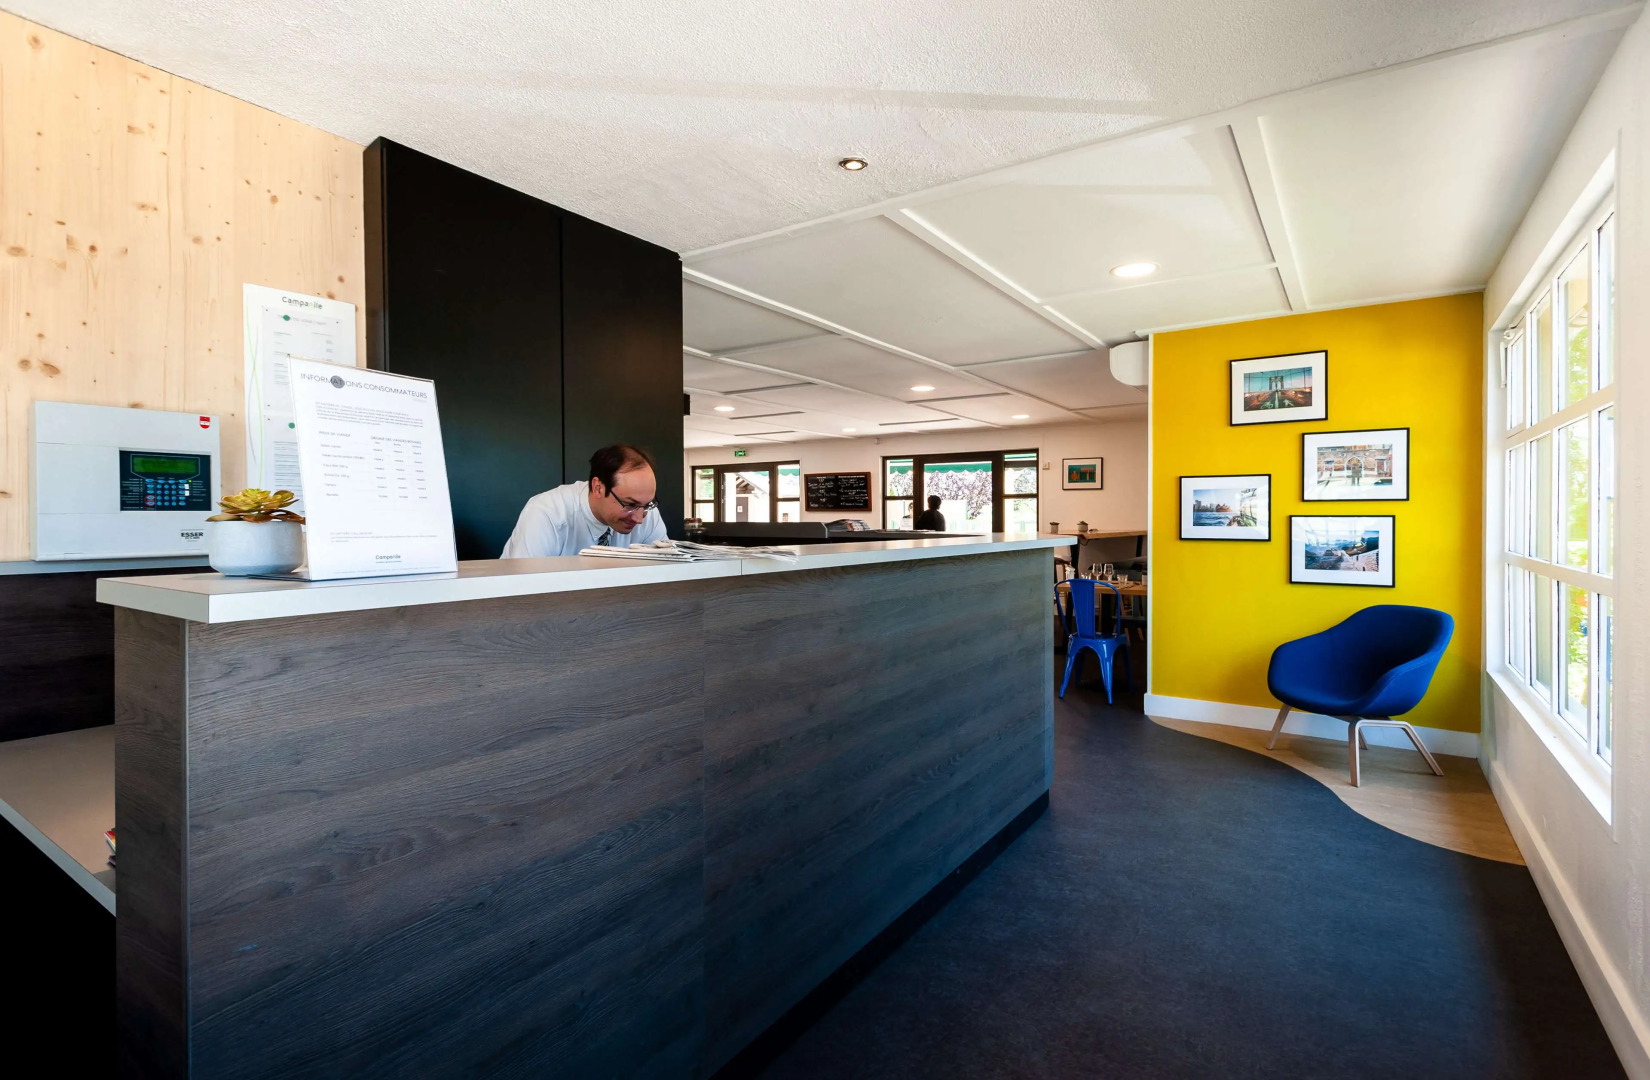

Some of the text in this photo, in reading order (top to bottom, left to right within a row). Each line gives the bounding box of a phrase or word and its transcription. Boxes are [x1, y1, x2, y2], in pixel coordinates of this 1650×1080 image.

[282, 296, 323, 310] Campanile
[300, 372, 428, 399] INFORMATONS CONSOMMATEURS
